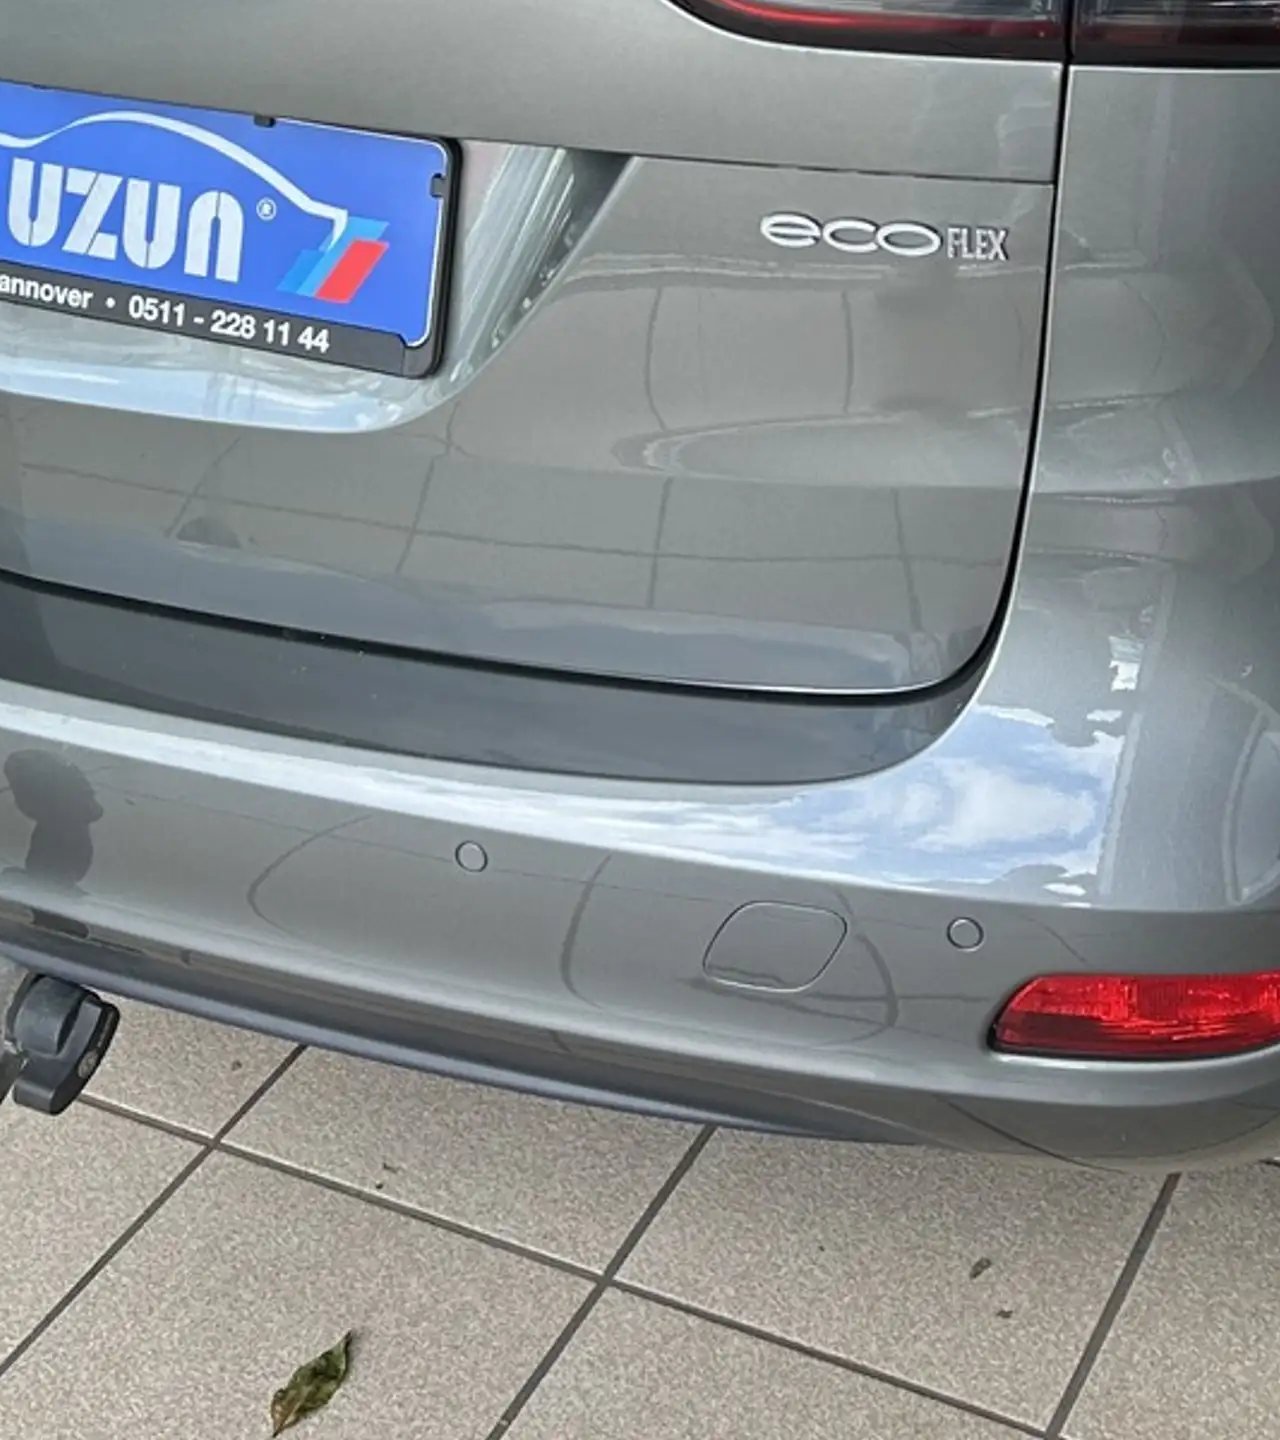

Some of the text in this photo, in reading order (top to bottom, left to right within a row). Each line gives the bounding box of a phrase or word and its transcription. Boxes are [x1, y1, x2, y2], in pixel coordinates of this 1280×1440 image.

[7, 156, 245, 284] UZUN
[128, 294, 186, 327] 0511
[210, 309, 257, 340] 228
[263, 319, 291, 347] 11
[296, 325, 330, 354] 44
